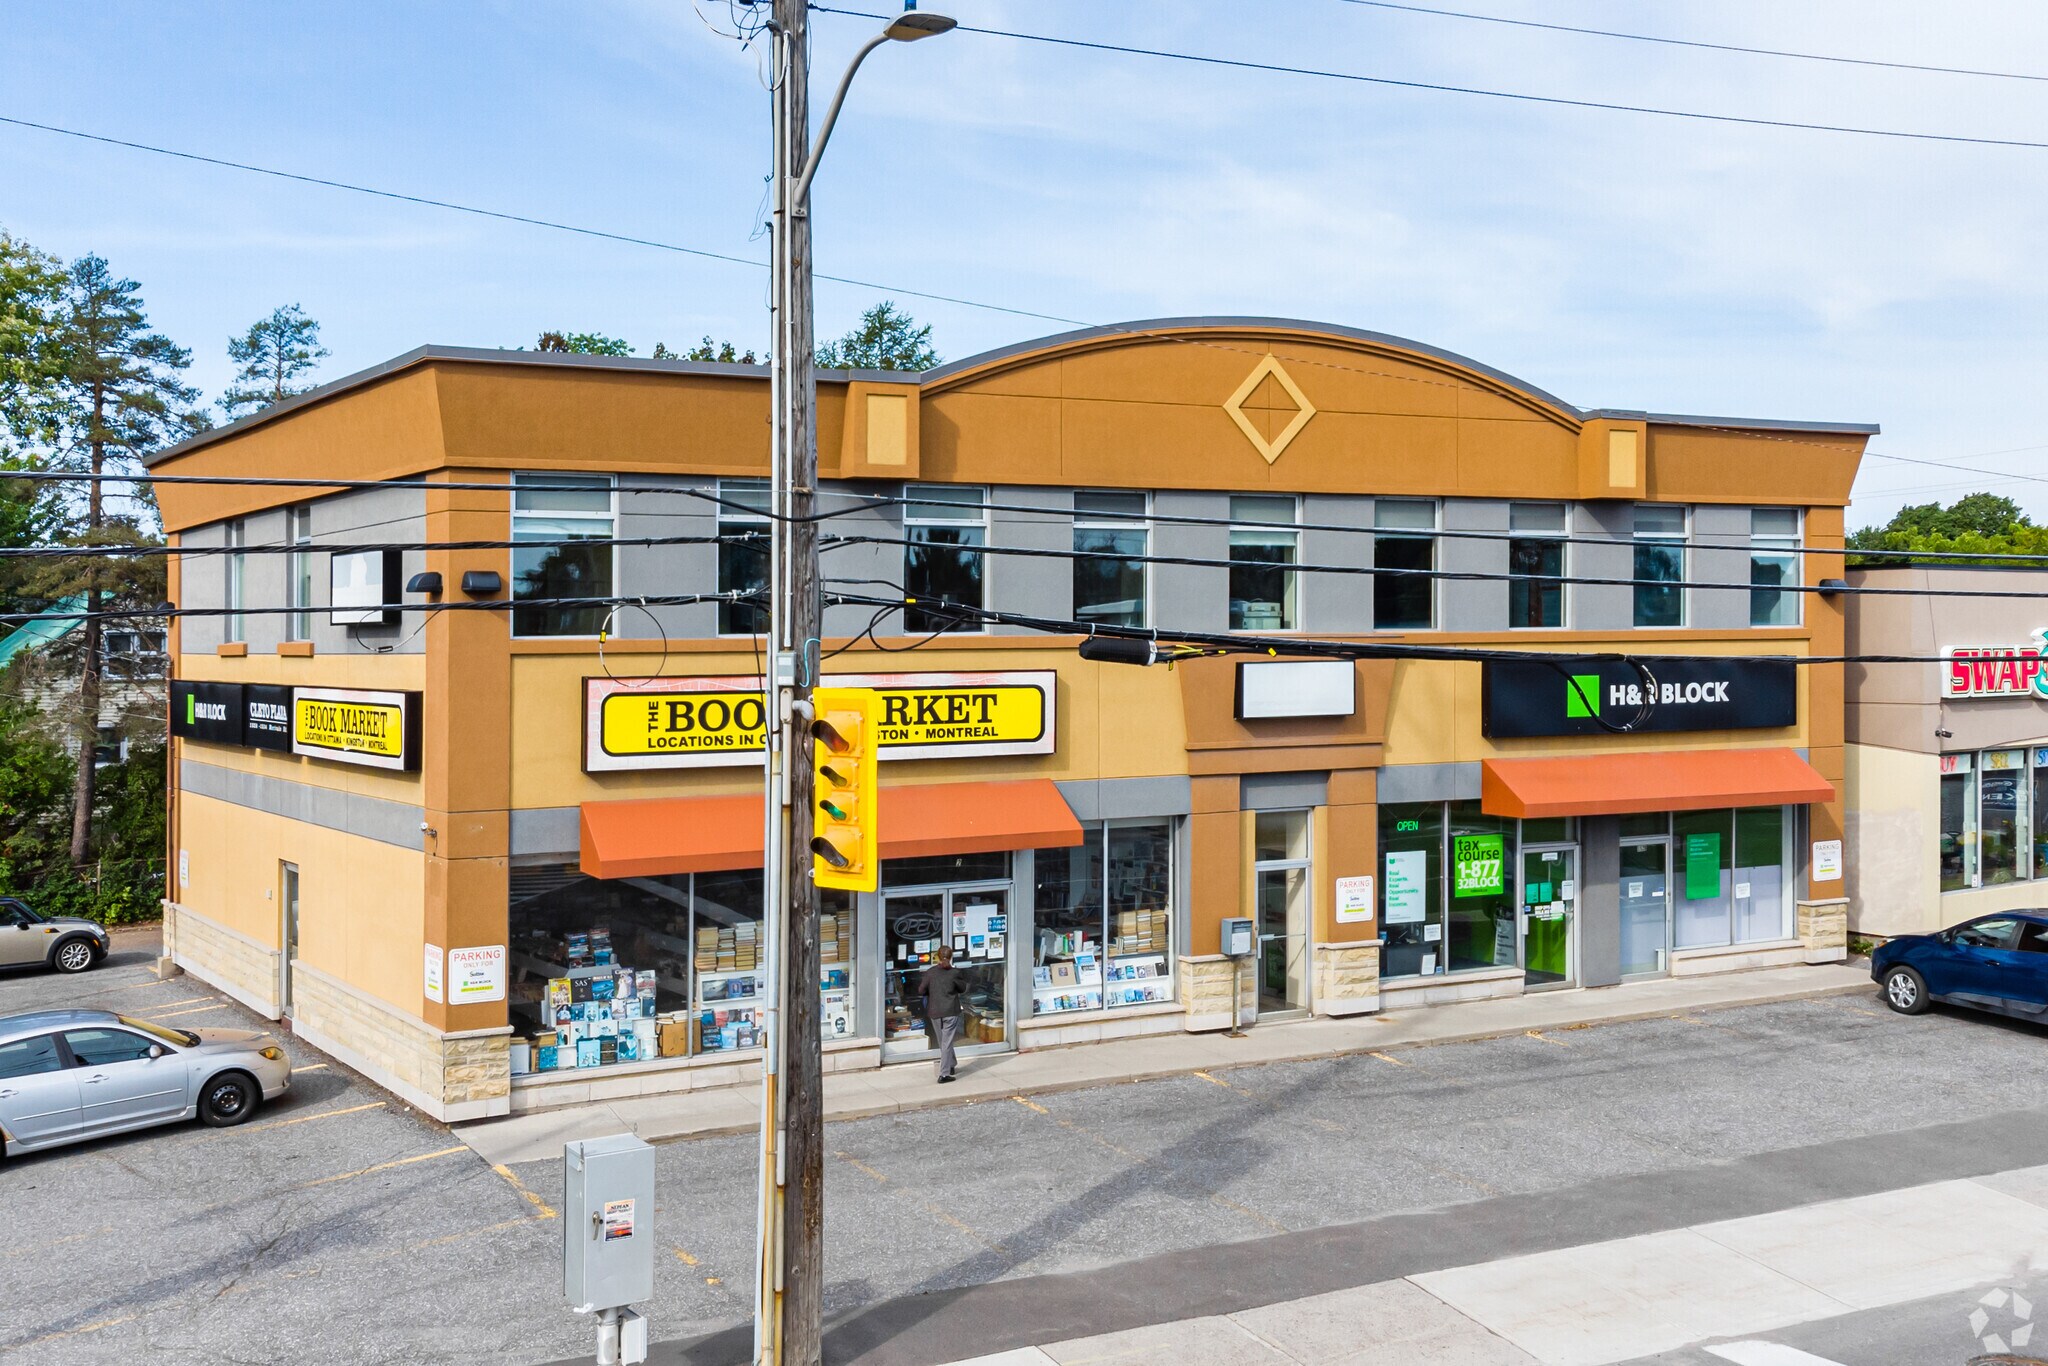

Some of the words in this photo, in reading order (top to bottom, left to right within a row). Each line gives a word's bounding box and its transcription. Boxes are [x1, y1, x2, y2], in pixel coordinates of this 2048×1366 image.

[1951, 648, 2040, 693] SWAP
[1661, 681, 1730, 704] BLOCK
[648, 701, 659, 732] THE
[665, 698, 766, 732] BOO
[878, 694, 998, 726] RKET
[309, 706, 337, 732] BOOK
[340, 708, 387, 738] MARKET
[926, 727, 999, 739] MONTREAL
[648, 735, 734, 748] LOCATIONS
[740, 734, 754, 745] IN
[1397, 821, 1419, 831] OPEN
[1458, 839, 1480, 851] tax
[1458, 849, 1500, 861] course
[1458, 860, 1500, 878] 1-877
[1340, 880, 1370, 888] PARKING
[1458, 876, 1500, 889] 32BLOCK
[897, 918, 941, 935] OPEN
[454, 950, 501, 962] PARKING
